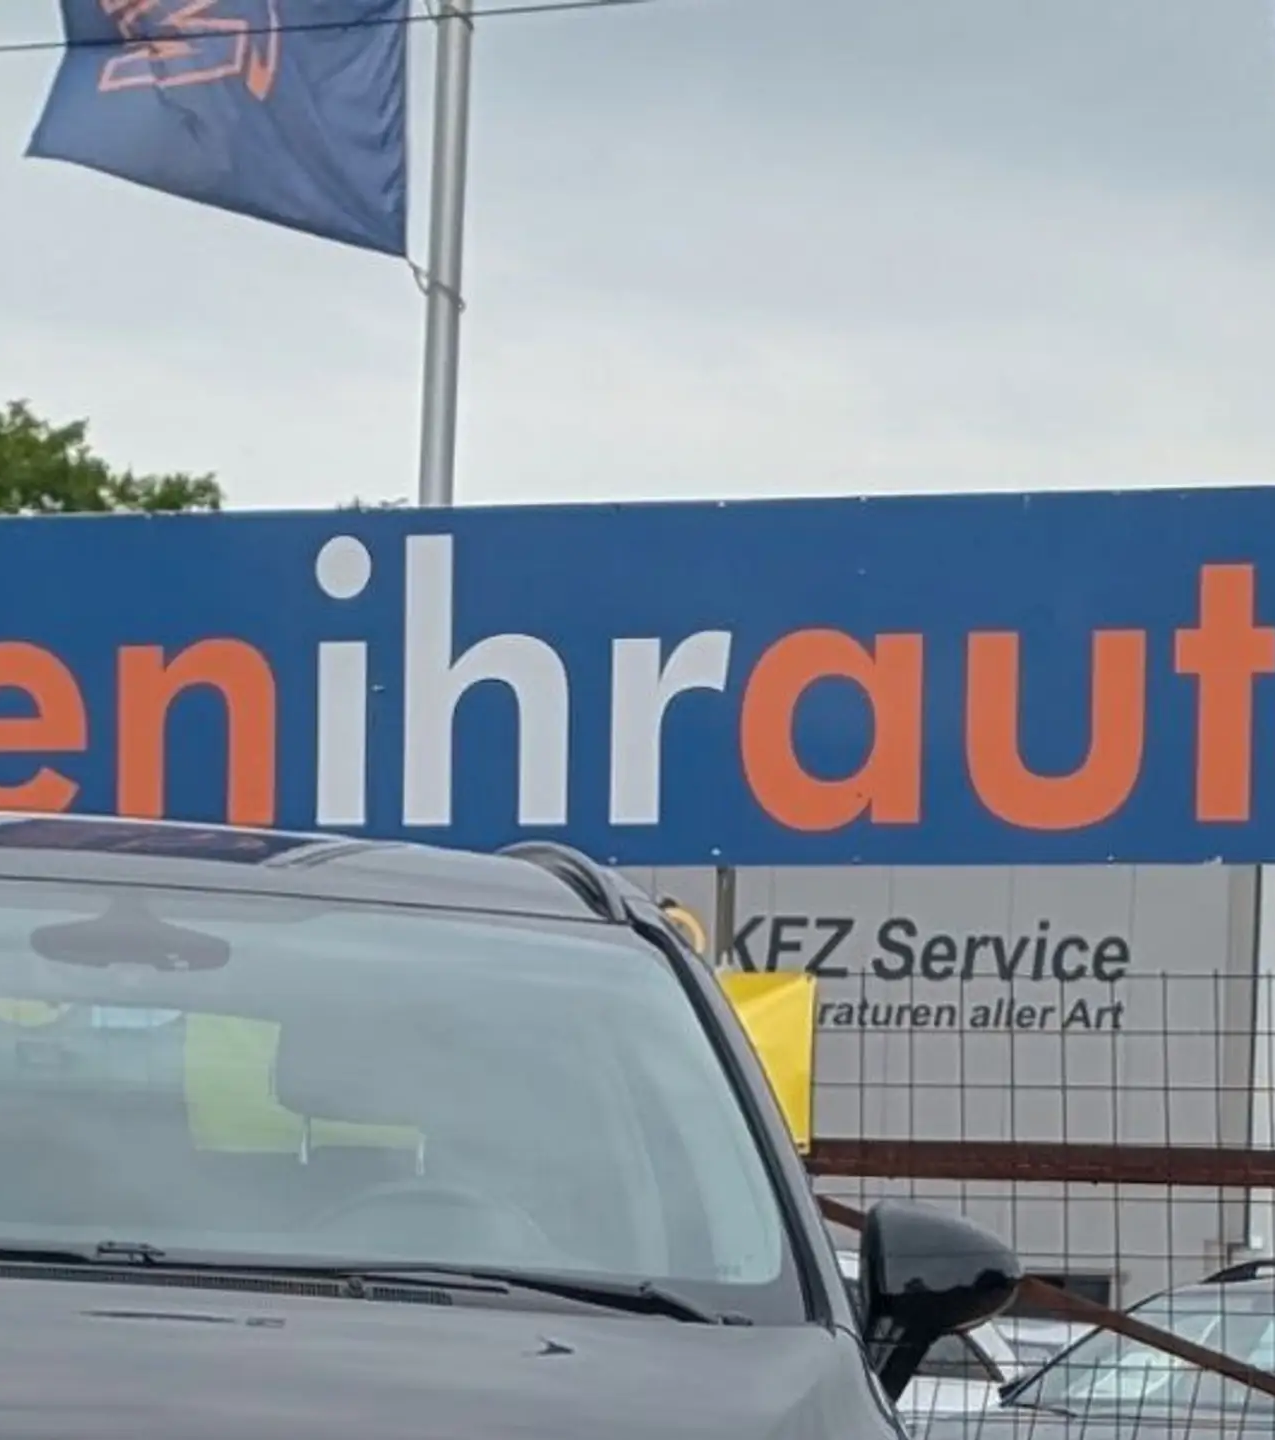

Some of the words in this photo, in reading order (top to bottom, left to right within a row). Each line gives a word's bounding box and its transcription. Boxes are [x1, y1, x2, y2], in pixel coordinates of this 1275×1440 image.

[731, 915, 855, 978] KFZ
[871, 916, 1131, 982] Service
[817, 1001, 956, 1028] raturen
[969, 999, 1056, 1029] aller
[1063, 998, 1124, 1030] Art
